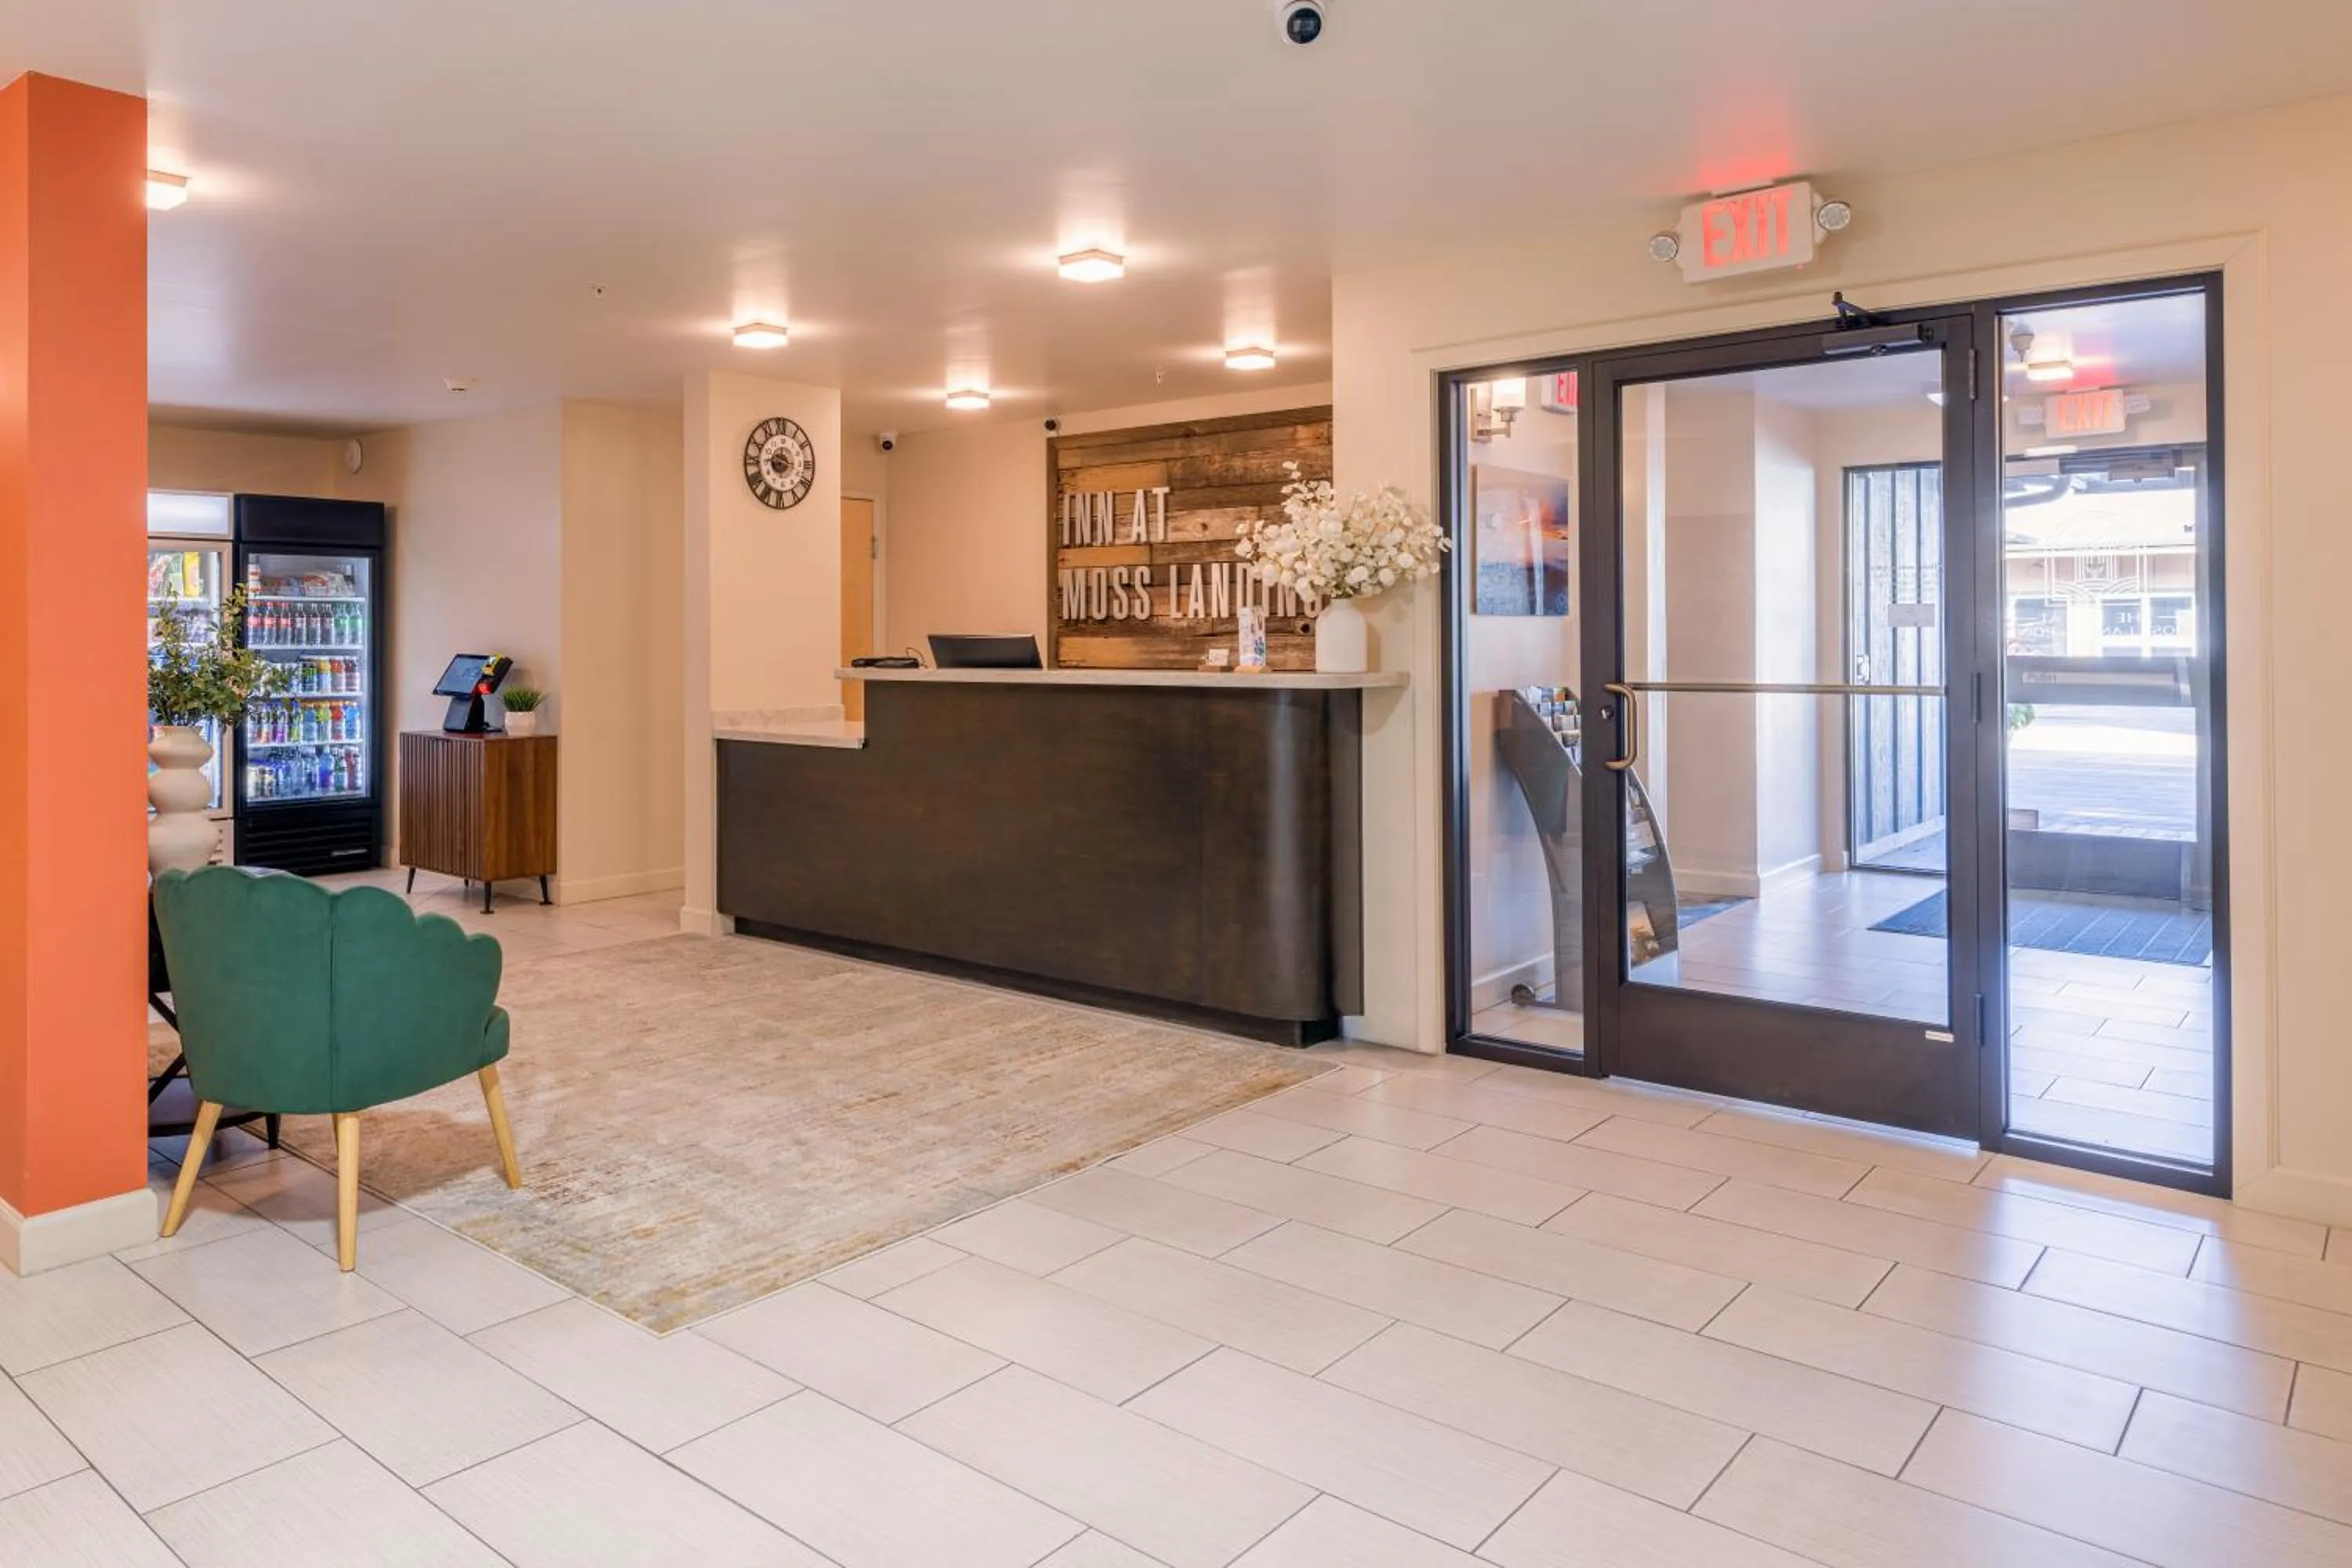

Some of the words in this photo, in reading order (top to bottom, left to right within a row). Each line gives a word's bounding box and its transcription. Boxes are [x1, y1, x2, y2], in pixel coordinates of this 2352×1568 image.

[1702, 188, 1794, 268] EXIT
[2057, 392, 2111, 431] EXIT
[1062, 489, 1113, 546] INN
[1131, 486, 1170, 543] AT
[1062, 565, 1151, 620] MOSS
